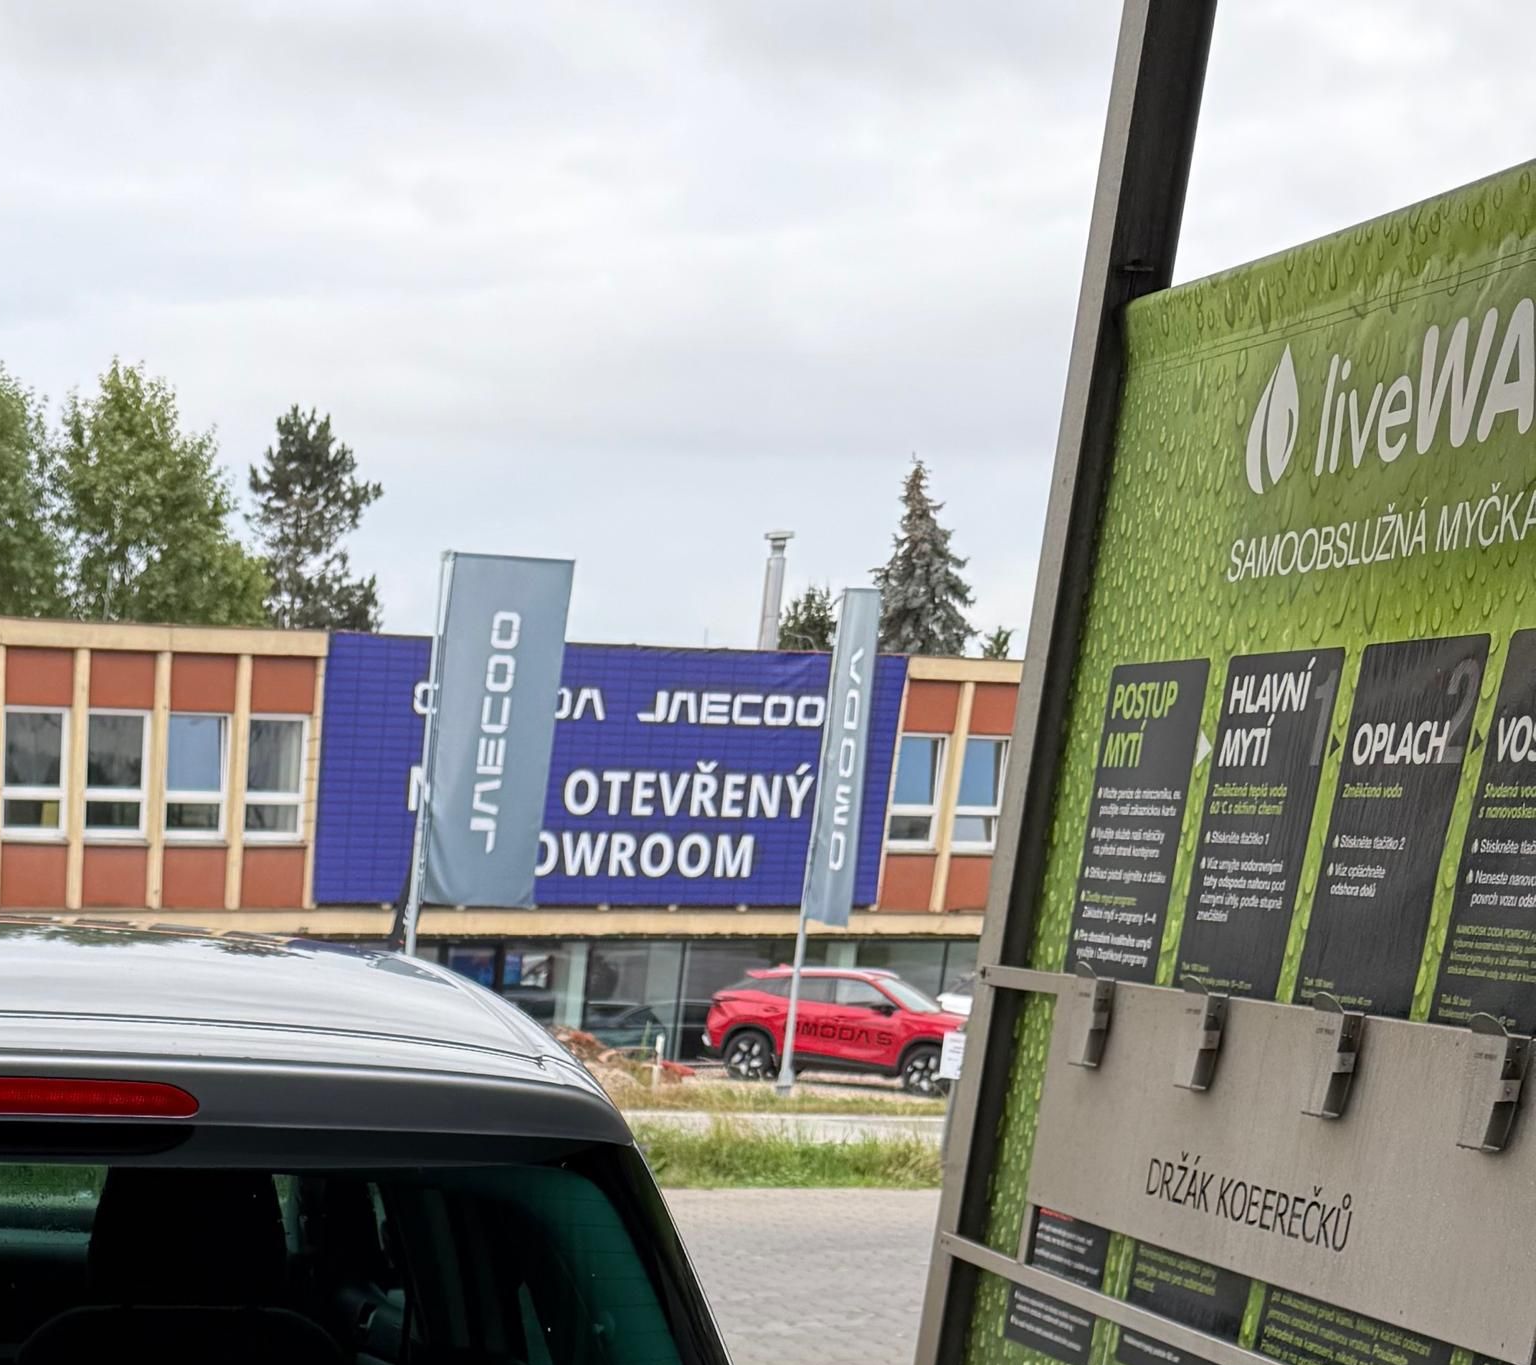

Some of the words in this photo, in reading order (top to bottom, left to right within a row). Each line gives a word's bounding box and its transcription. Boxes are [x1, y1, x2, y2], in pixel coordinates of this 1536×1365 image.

[1227, 496, 1429, 583] SAMOOBSLUŽNÁ
[636, 690, 826, 727] JAECOO
[1111, 681, 1179, 720] POSTUP
[1228, 657, 1316, 714] HLAVNÍ
[470, 611, 522, 853] JAECOO
[1102, 719, 1148, 768] MYTÍ
[1218, 714, 1276, 767] MYTÍ
[1352, 719, 1451, 766] OPLACH
[564, 760, 815, 818] OTEVŘENÝ
[1146, 1151, 1214, 1214] DRŽÁK
